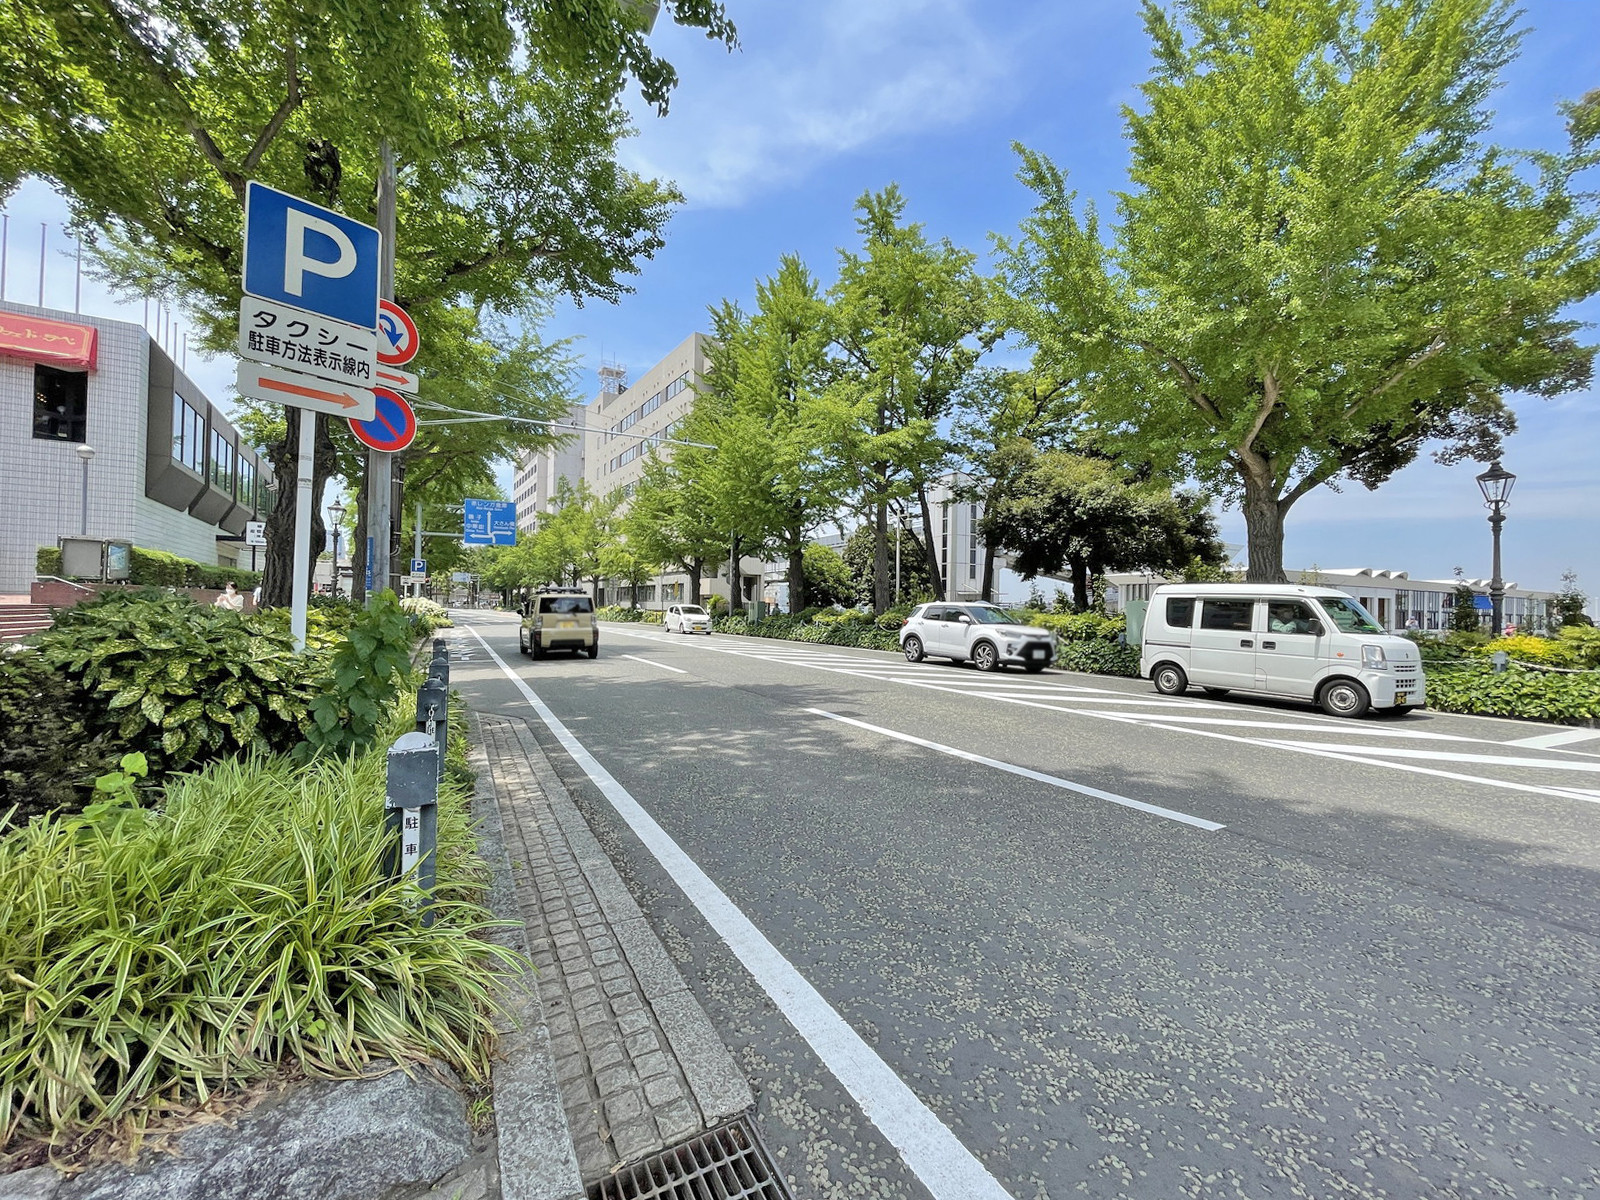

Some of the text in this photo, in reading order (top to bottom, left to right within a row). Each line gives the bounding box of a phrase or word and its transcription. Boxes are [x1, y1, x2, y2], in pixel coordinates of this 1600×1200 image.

[283, 207, 357, 297] P
[253, 310, 368, 351] タクシー
[247, 330, 370, 380] 駐車方法表示線内
[414, 561, 424, 571] P
